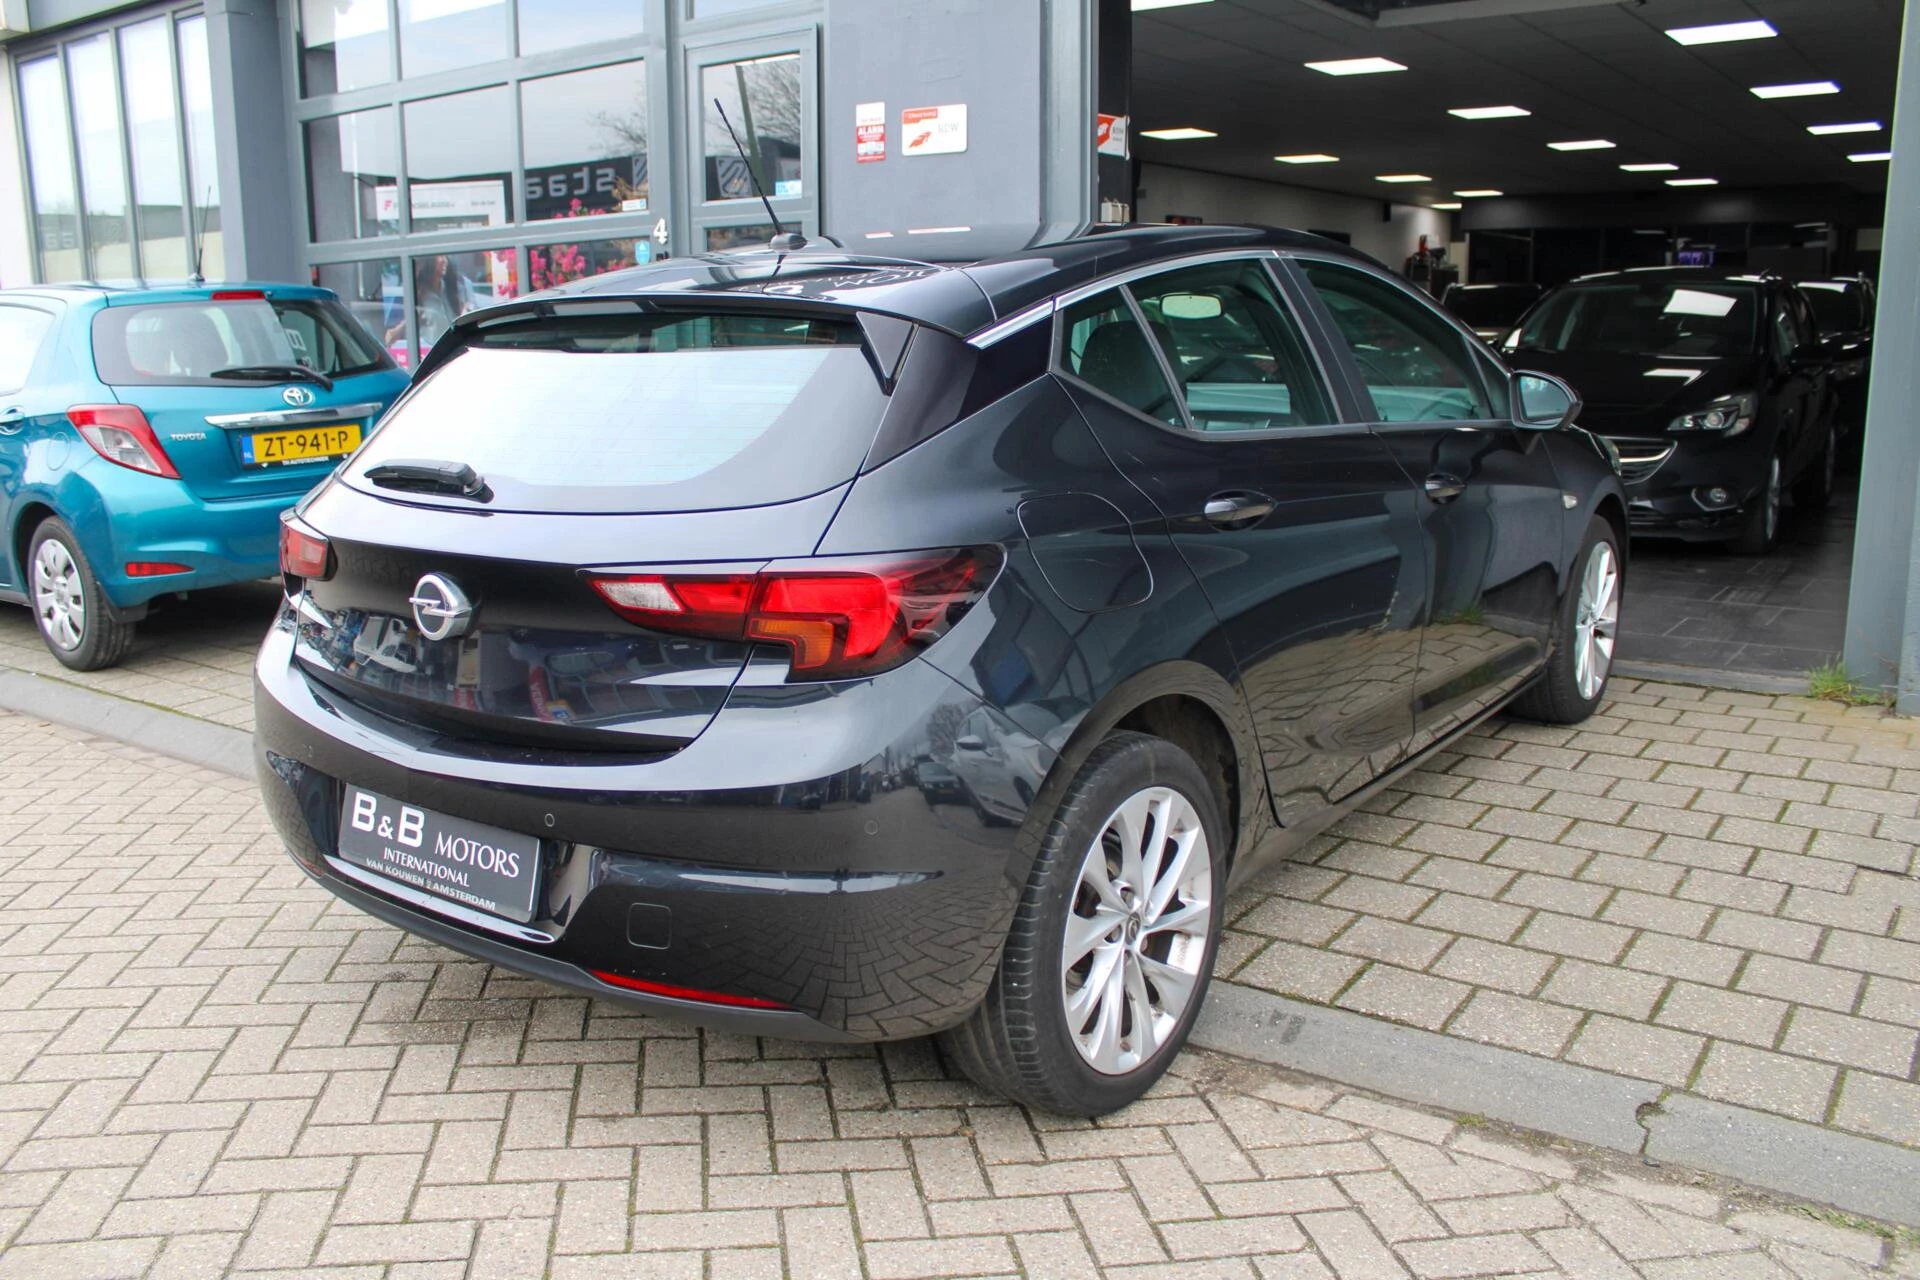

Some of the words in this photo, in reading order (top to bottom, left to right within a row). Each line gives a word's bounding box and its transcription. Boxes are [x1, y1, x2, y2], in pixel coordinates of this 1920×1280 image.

[653, 217, 668, 245] 4
[170, 432, 207, 441] TOYOTA
[263, 430, 348, 457] ZT-941-P
[383, 847, 470, 888] INTERNATIONAL
[434, 831, 520, 878] MOTORS
[366, 858, 383, 871] VAN
[385, 865, 425, 886] KOUWEN
[433, 881, 496, 910] AMSTERDAM
